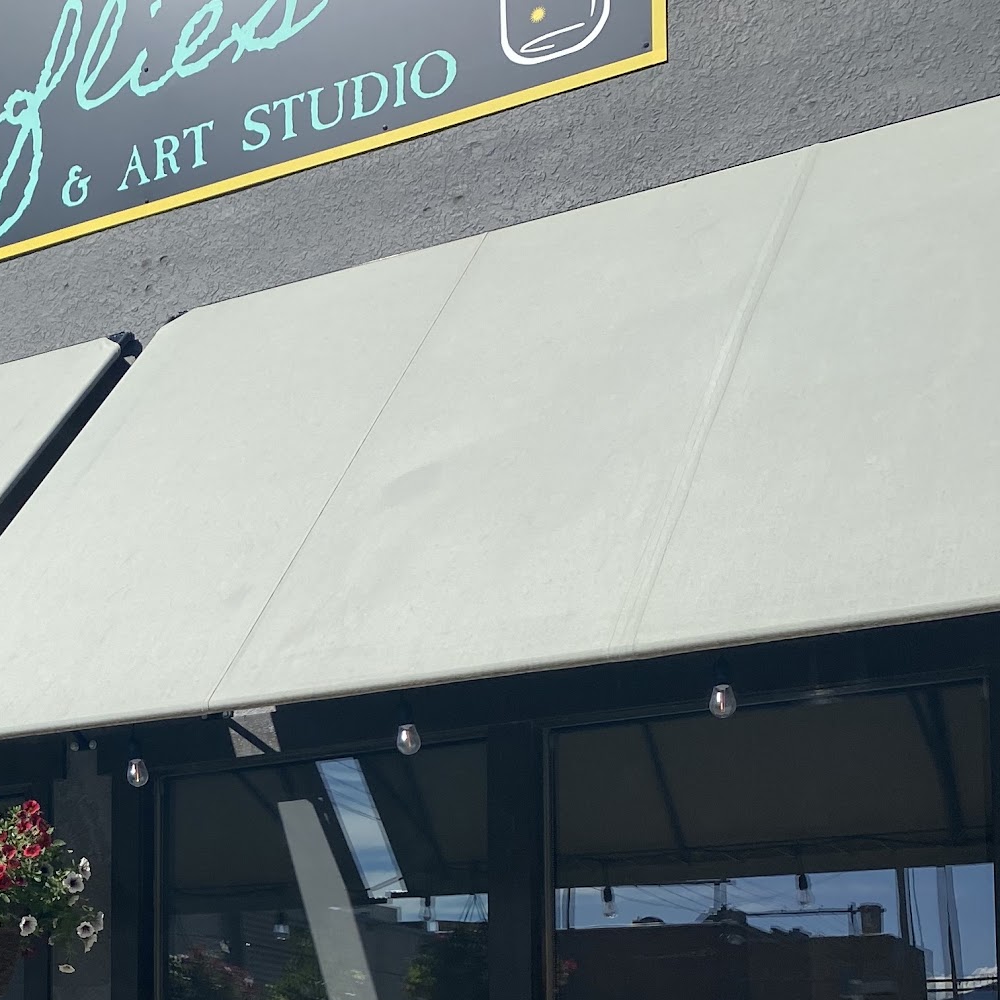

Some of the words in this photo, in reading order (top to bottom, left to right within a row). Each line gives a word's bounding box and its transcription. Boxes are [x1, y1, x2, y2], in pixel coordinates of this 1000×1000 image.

[62, 165, 92, 208] &
[116, 121, 214, 191] ART
[242, 50, 457, 151] STUDIO
